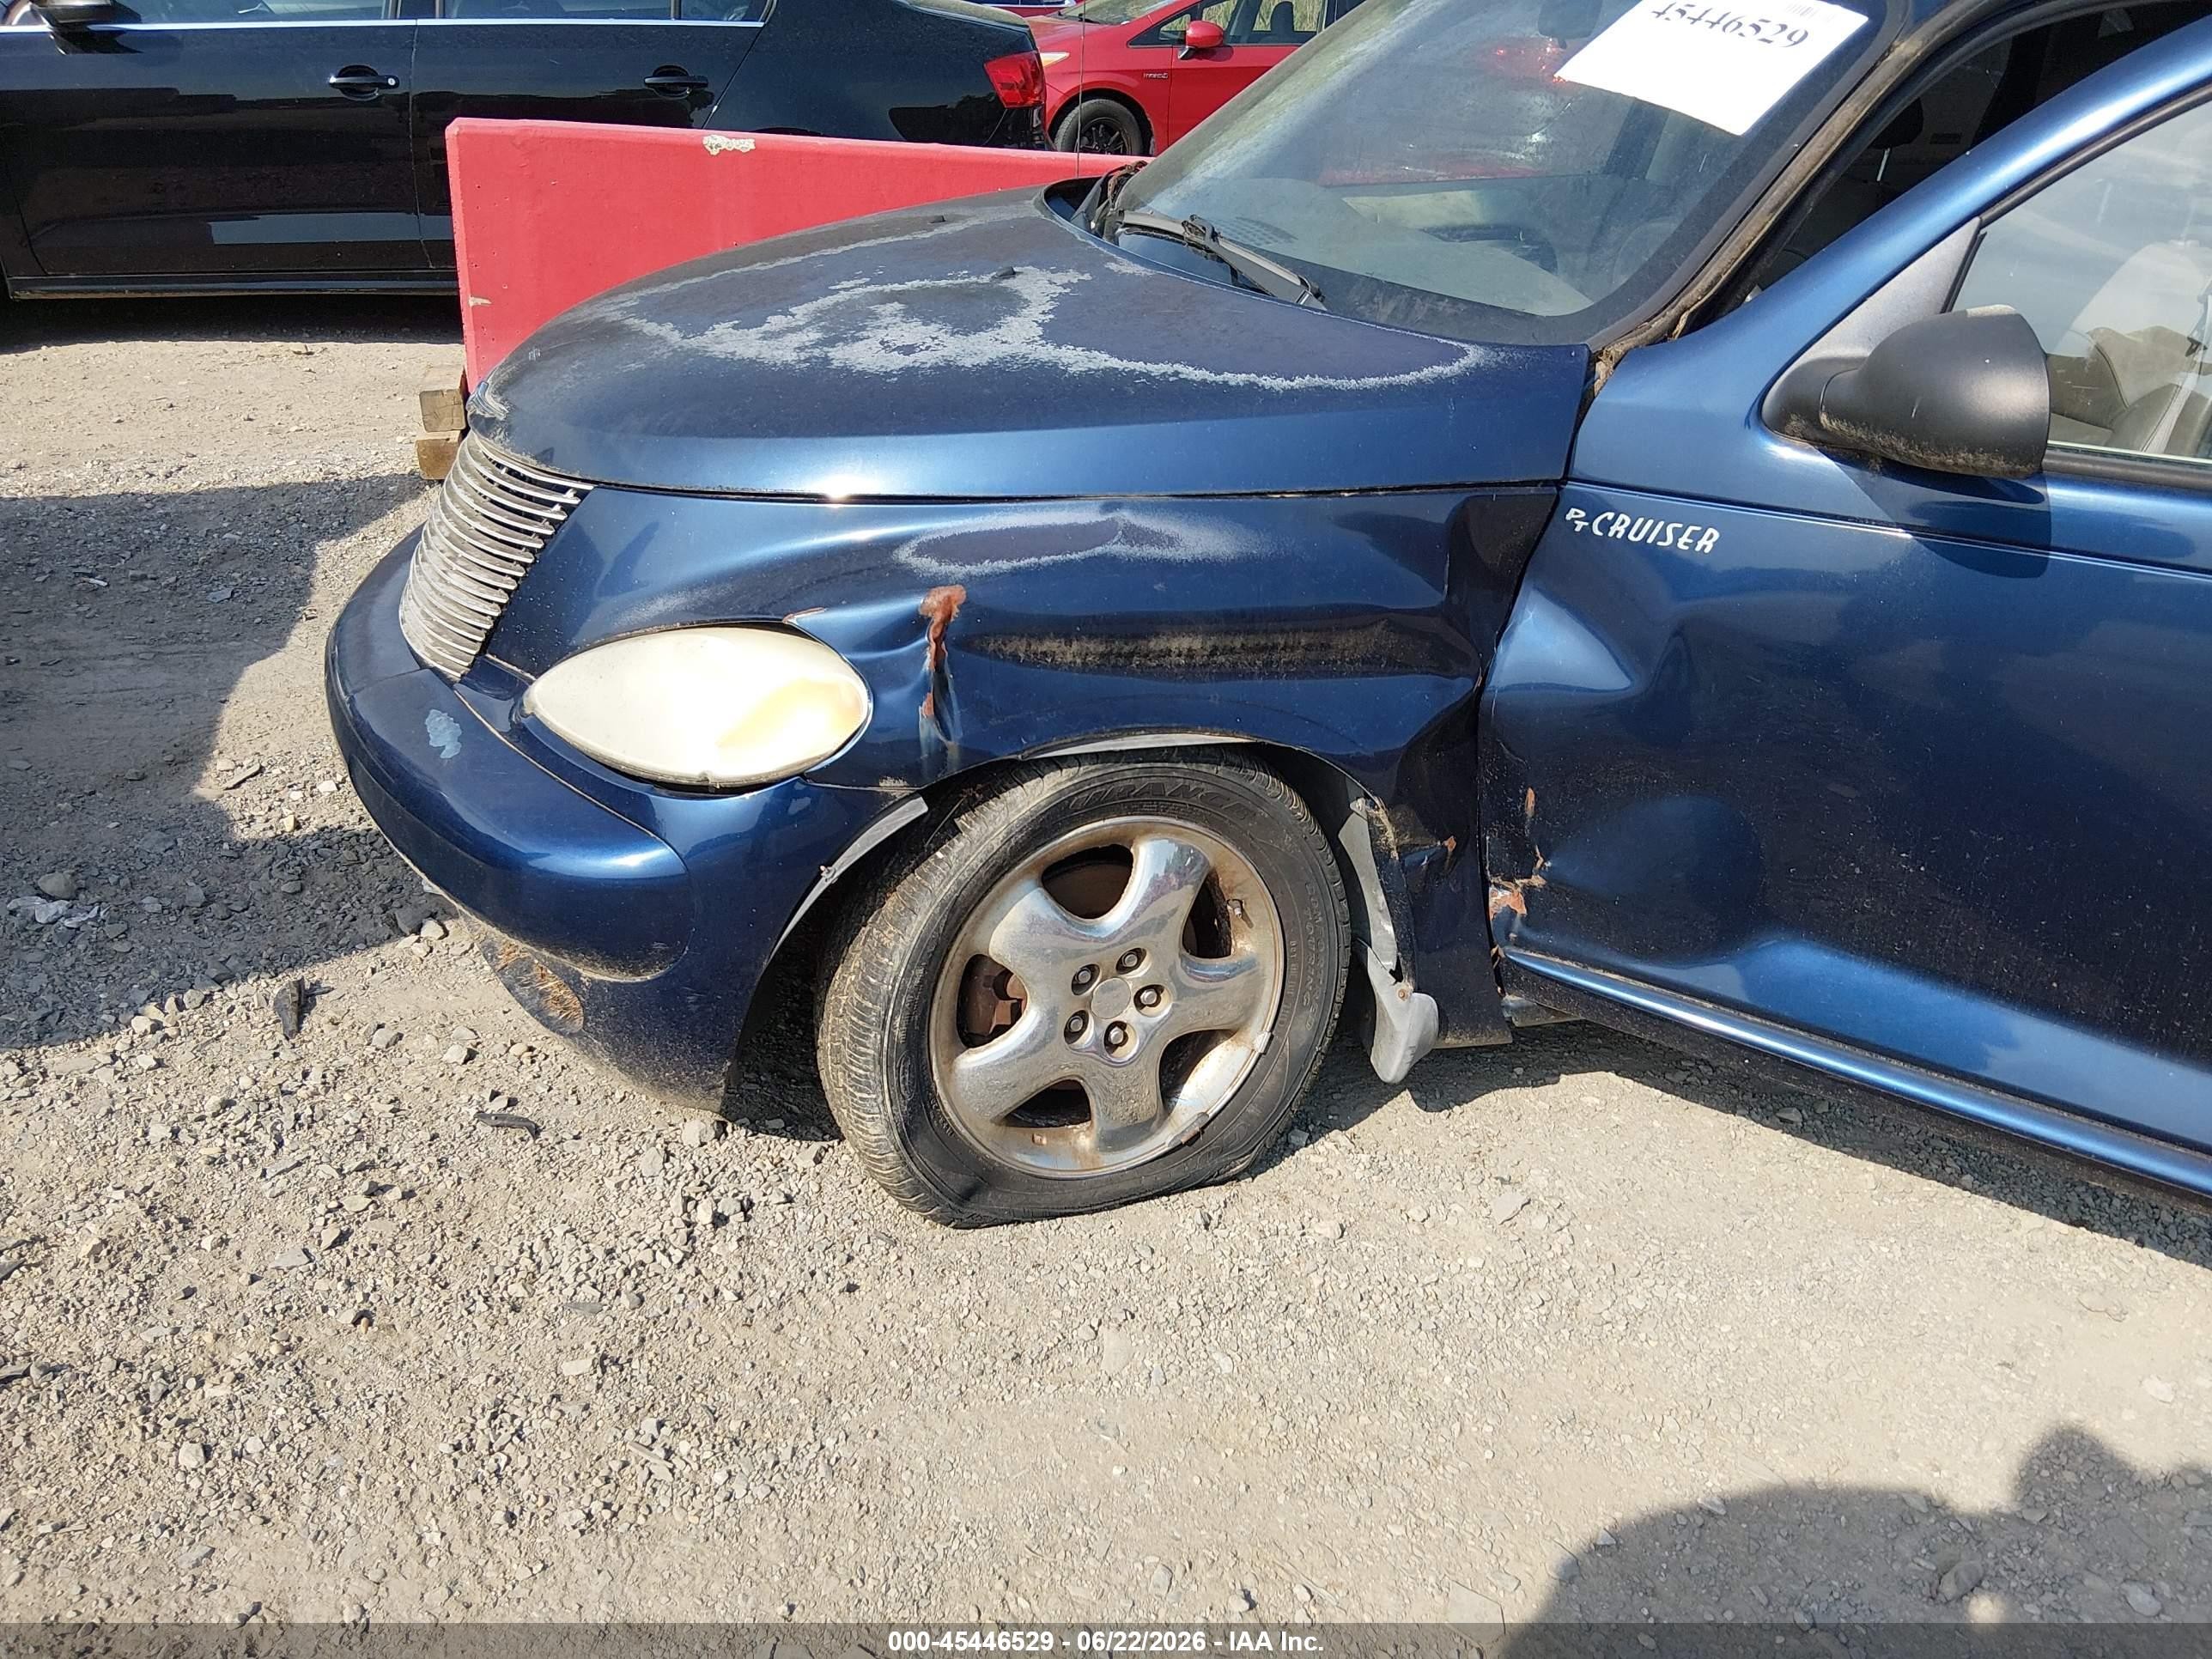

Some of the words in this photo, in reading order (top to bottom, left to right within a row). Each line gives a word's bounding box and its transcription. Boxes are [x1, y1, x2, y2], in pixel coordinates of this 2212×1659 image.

[1650, 1, 1810, 48] 45446529
[1565, 507, 1589, 532] PT
[1592, 511, 1721, 554] CRUISER
